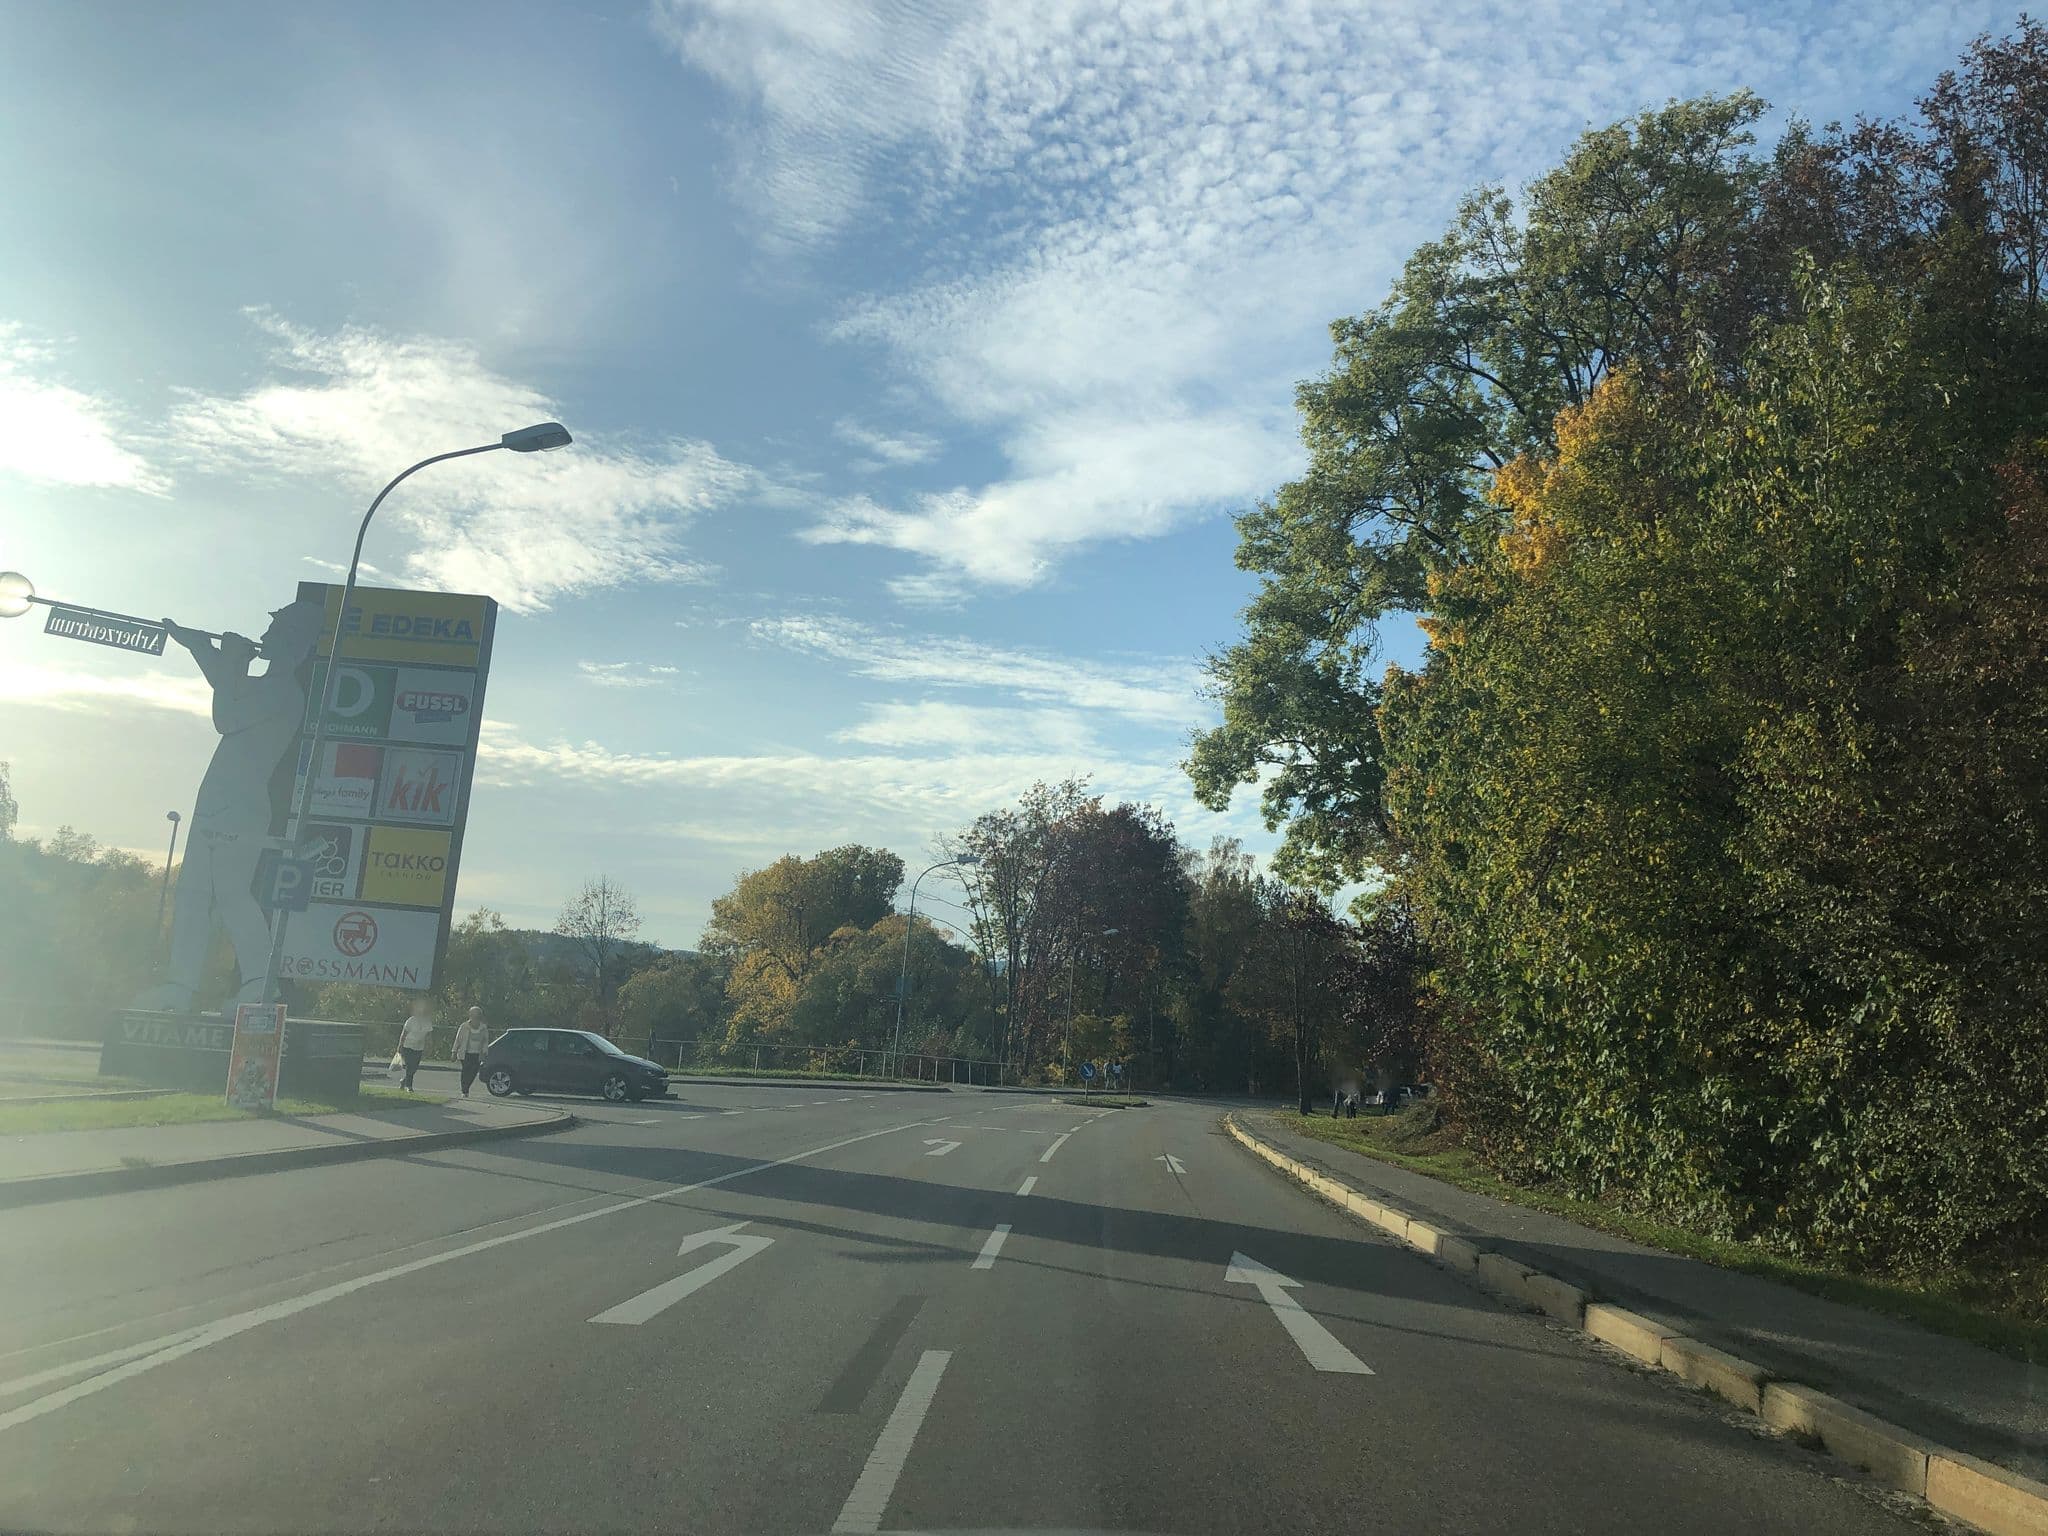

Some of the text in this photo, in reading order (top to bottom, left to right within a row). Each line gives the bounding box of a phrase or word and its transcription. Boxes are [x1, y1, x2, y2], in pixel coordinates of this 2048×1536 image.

[371, 613, 473, 640] EDEKA
[404, 694, 463, 712] FUSSL
[271, 864, 301, 901] P
[280, 955, 419, 984] ROSSMANN
